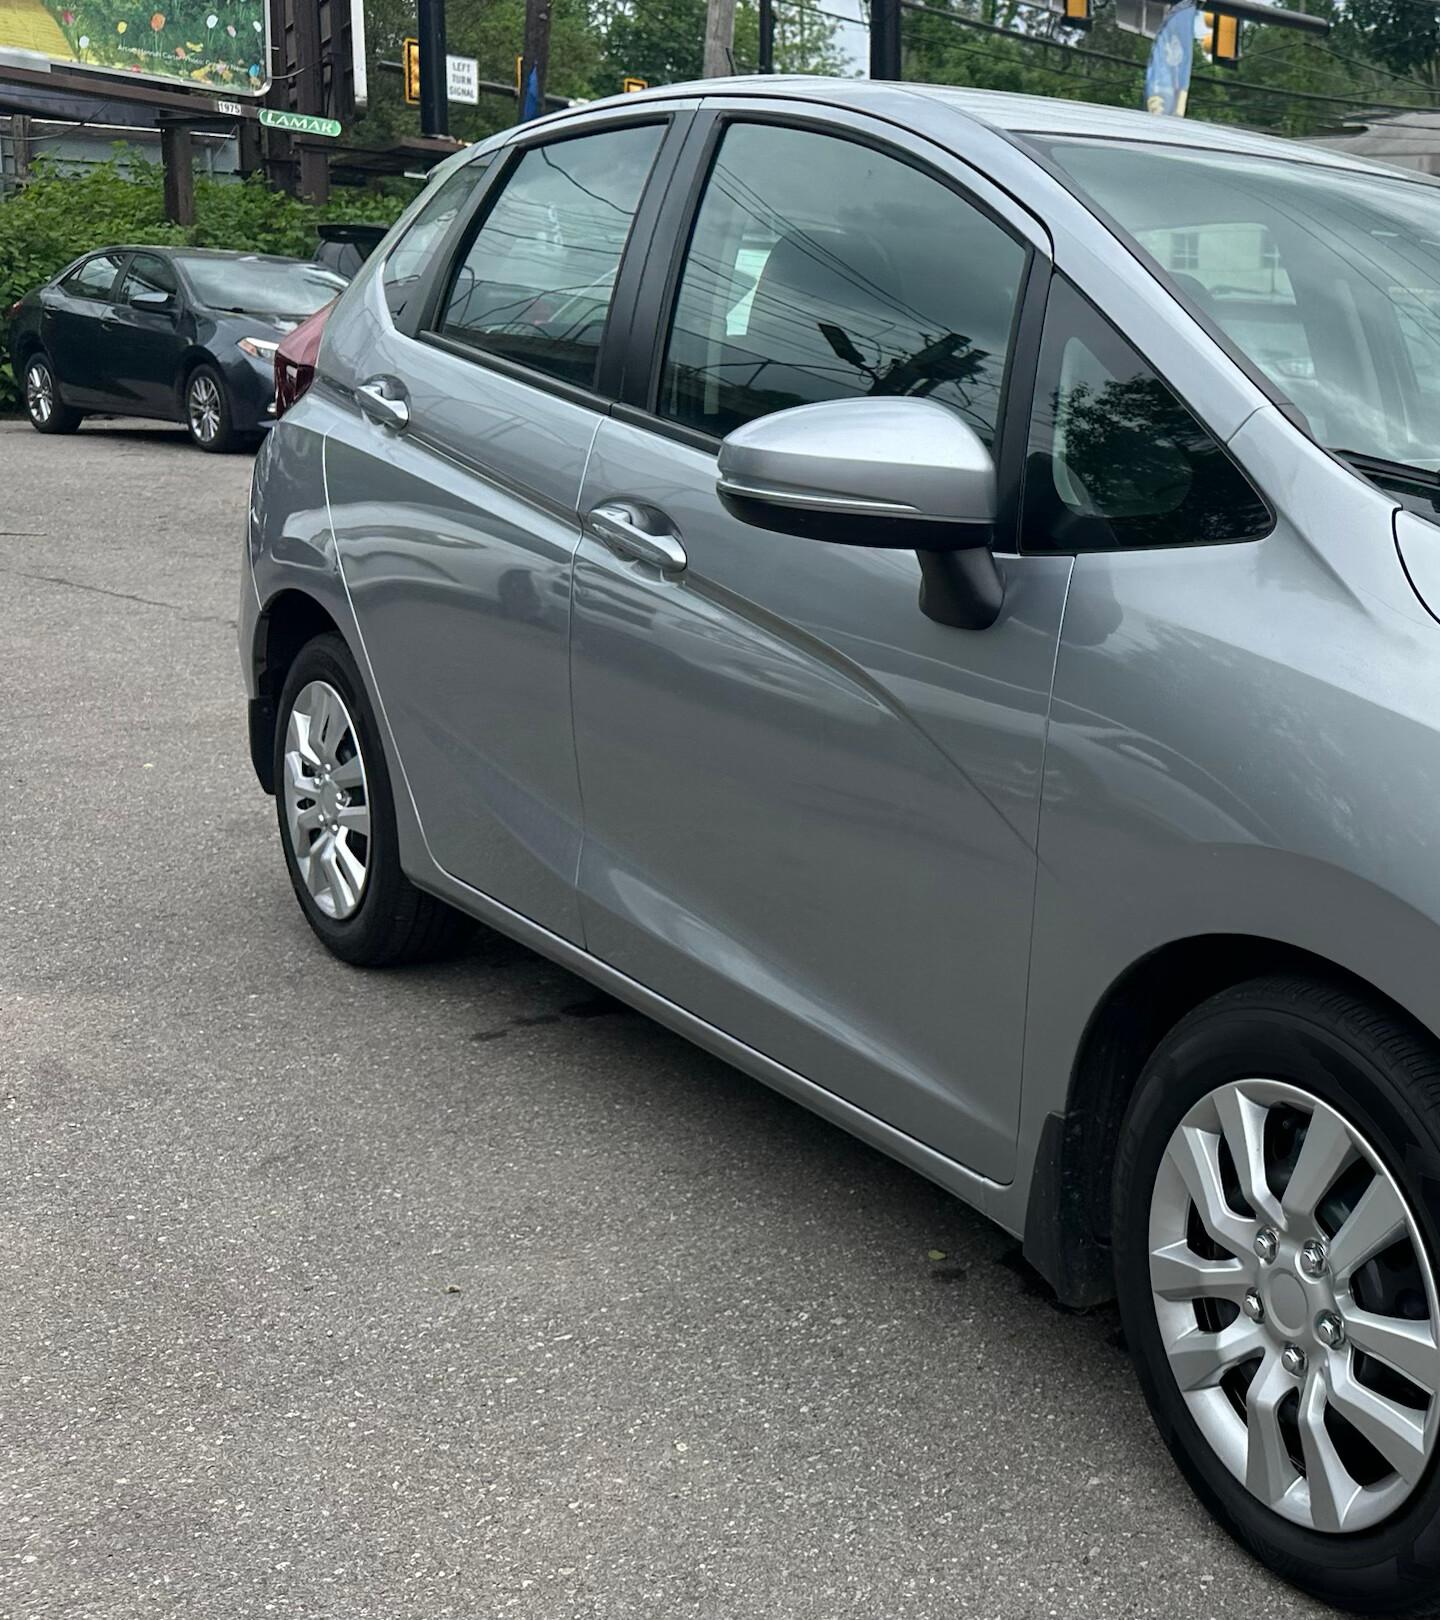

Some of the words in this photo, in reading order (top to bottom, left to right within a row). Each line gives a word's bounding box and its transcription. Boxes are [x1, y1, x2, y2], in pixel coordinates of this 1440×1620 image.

[452, 62, 471, 73] LEFT
[452, 74, 472, 85] TURN
[449, 86, 475, 99] SIGNAL
[219, 101, 241, 115] 1975
[266, 112, 332, 133] LAMAR
